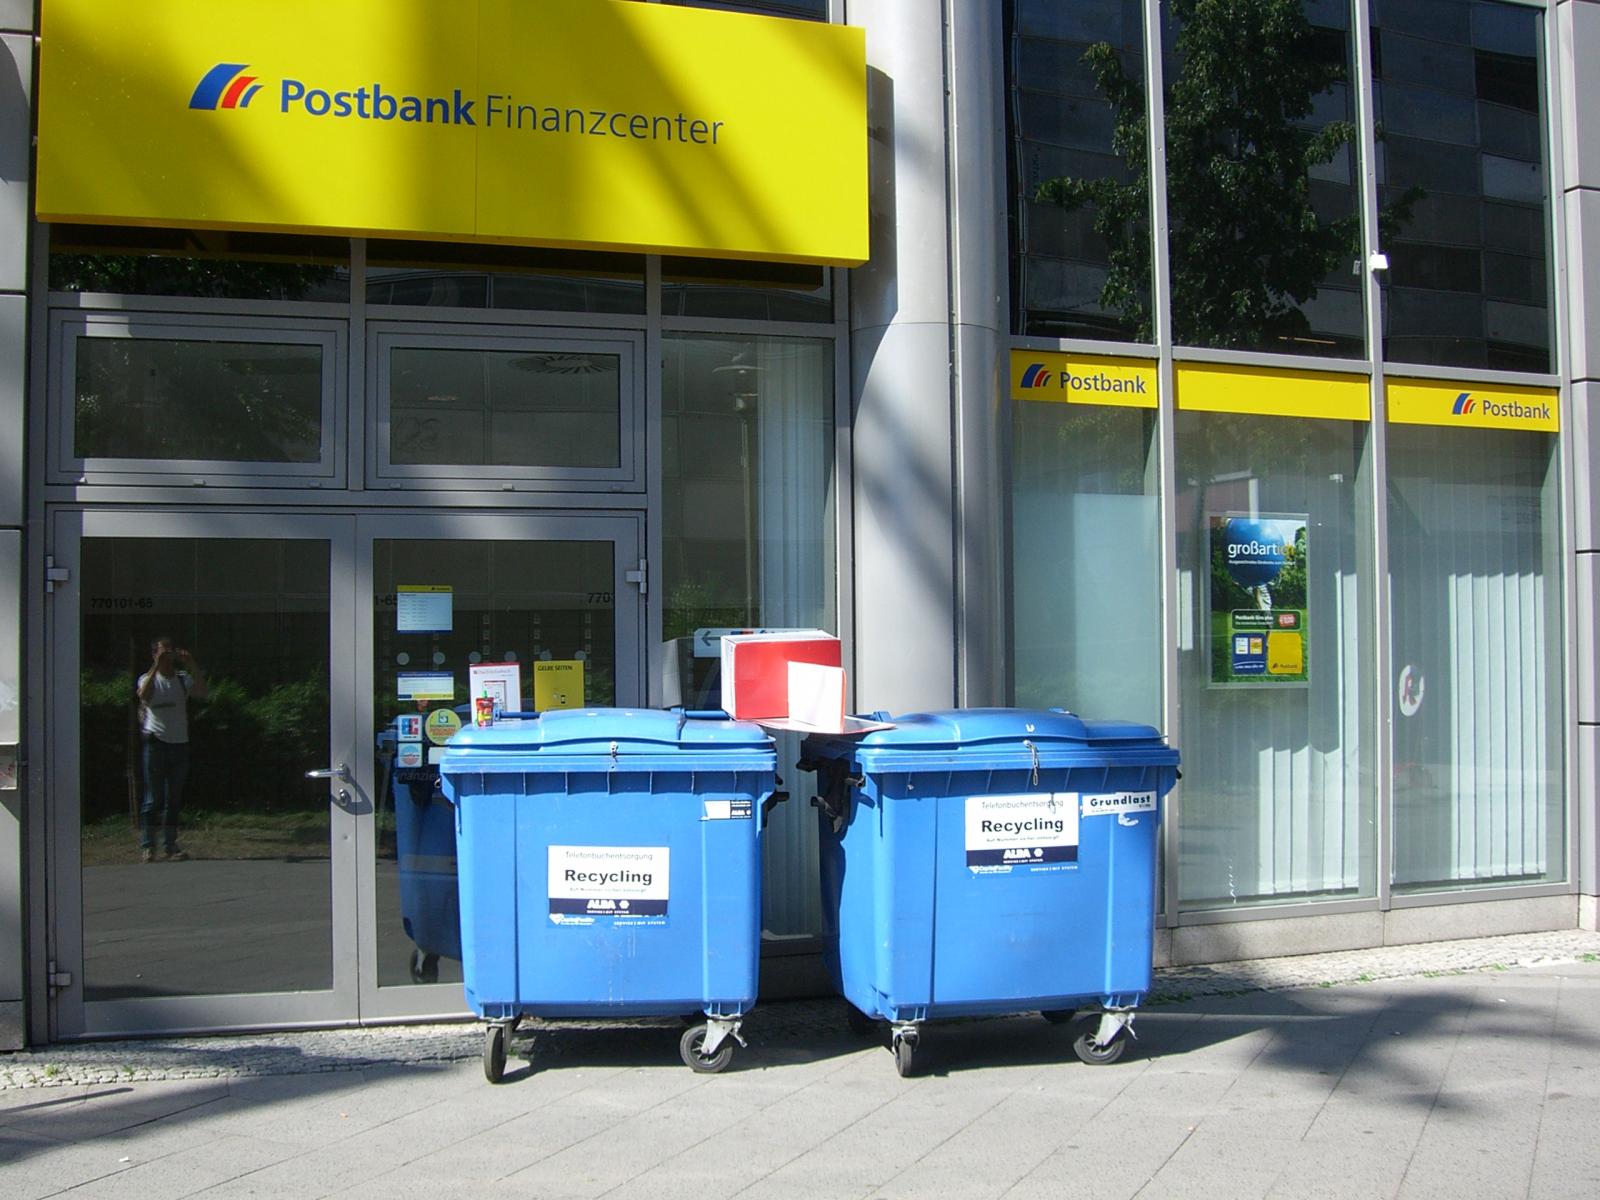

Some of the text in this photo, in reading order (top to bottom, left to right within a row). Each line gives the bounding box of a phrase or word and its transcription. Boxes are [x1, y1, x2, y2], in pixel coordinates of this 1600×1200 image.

[280, 79, 724, 145] Postbank Finanzcenter
[1060, 371, 1146, 394] Postbank
[1482, 399, 1550, 419] Postbank
[1090, 795, 1151, 807] Grundlast
[981, 818, 1064, 835] Recycling
[564, 869, 653, 886] Recycling
